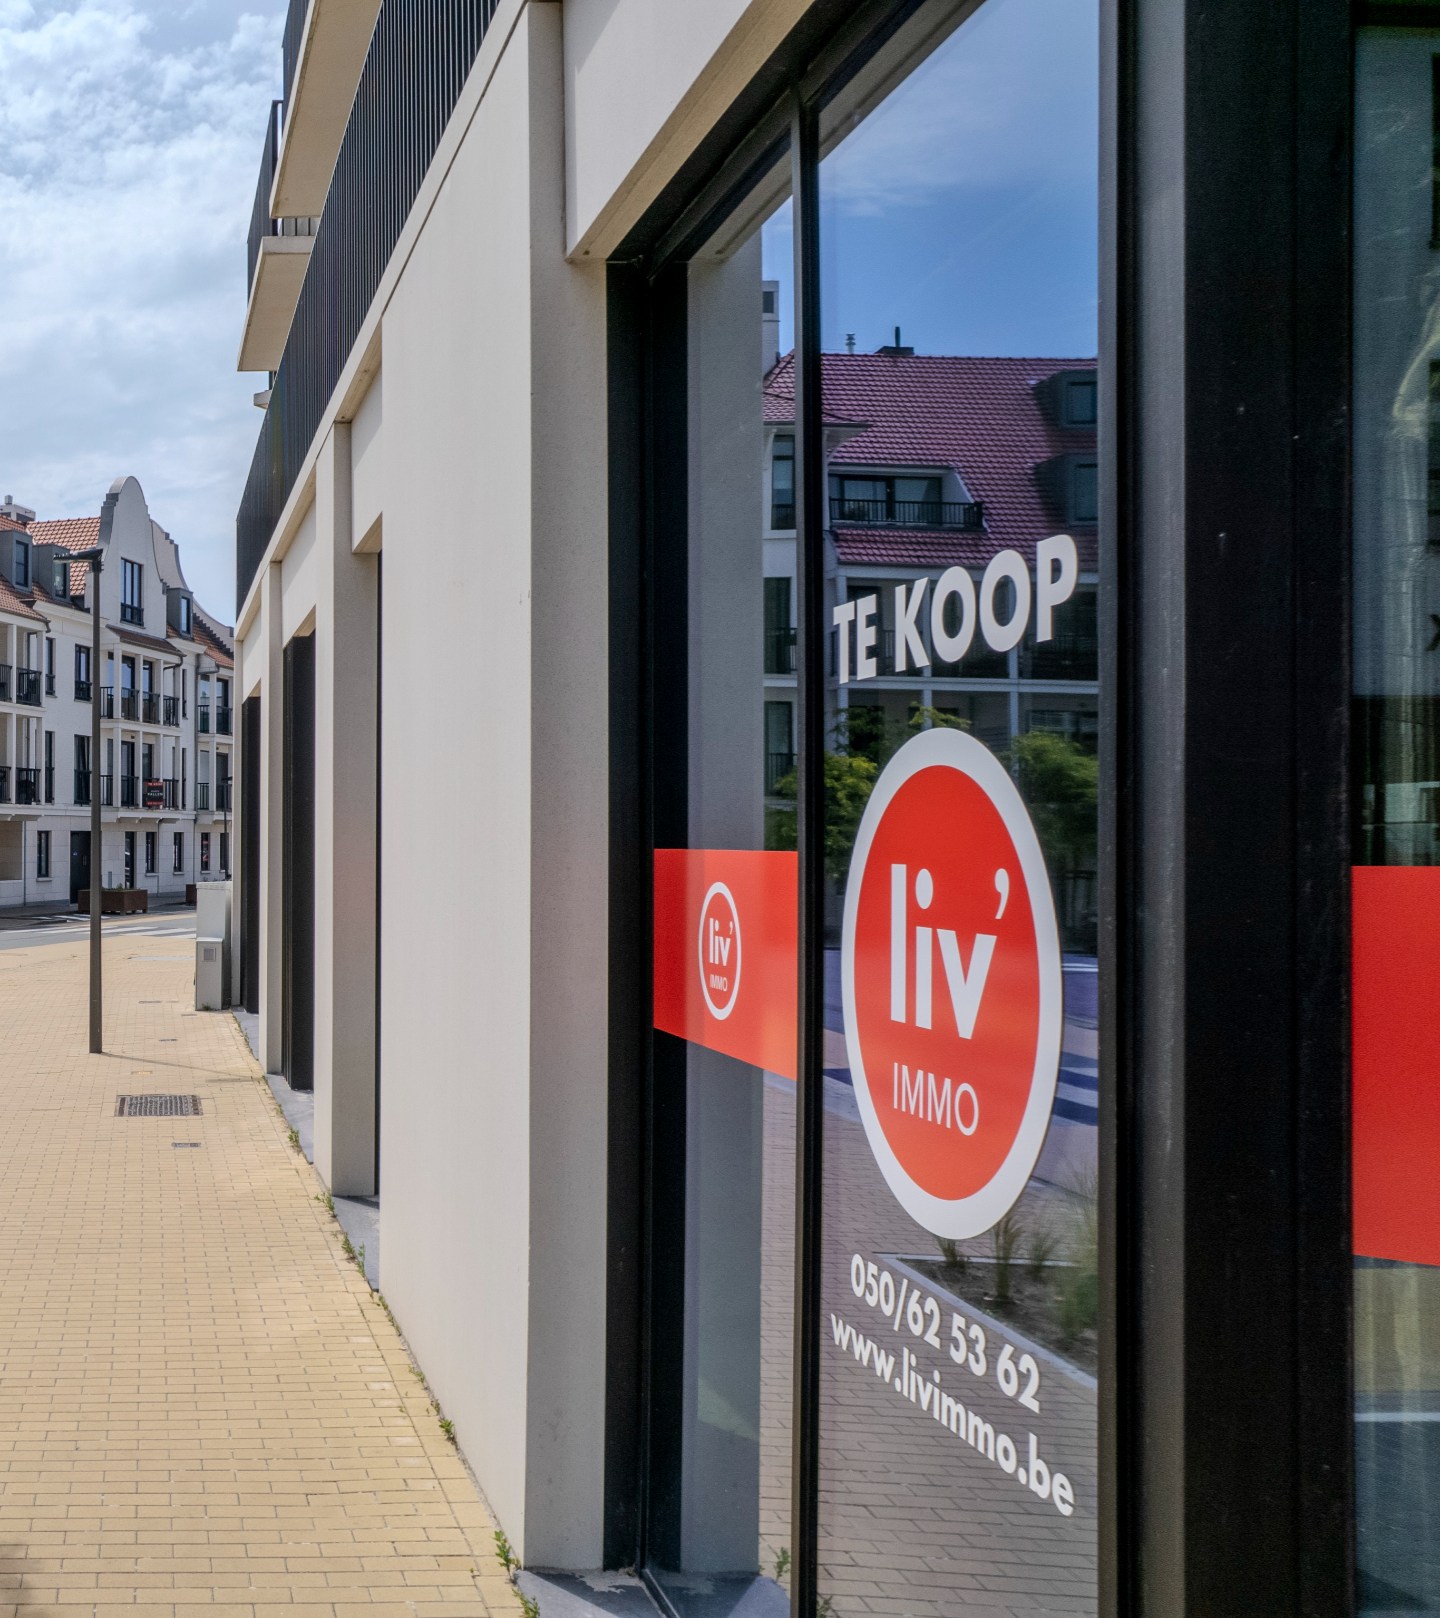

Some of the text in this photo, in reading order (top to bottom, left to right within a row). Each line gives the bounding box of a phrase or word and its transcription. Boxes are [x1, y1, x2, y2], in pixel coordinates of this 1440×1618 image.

[833, 534, 1078, 685] TE KOOP
[710, 974, 728, 992] IMMO
[893, 1062, 979, 1136] IMMO
[850, 1253, 1040, 1414] 050/62 53 62
[830, 1312, 1075, 1517] www.livimmo.be
